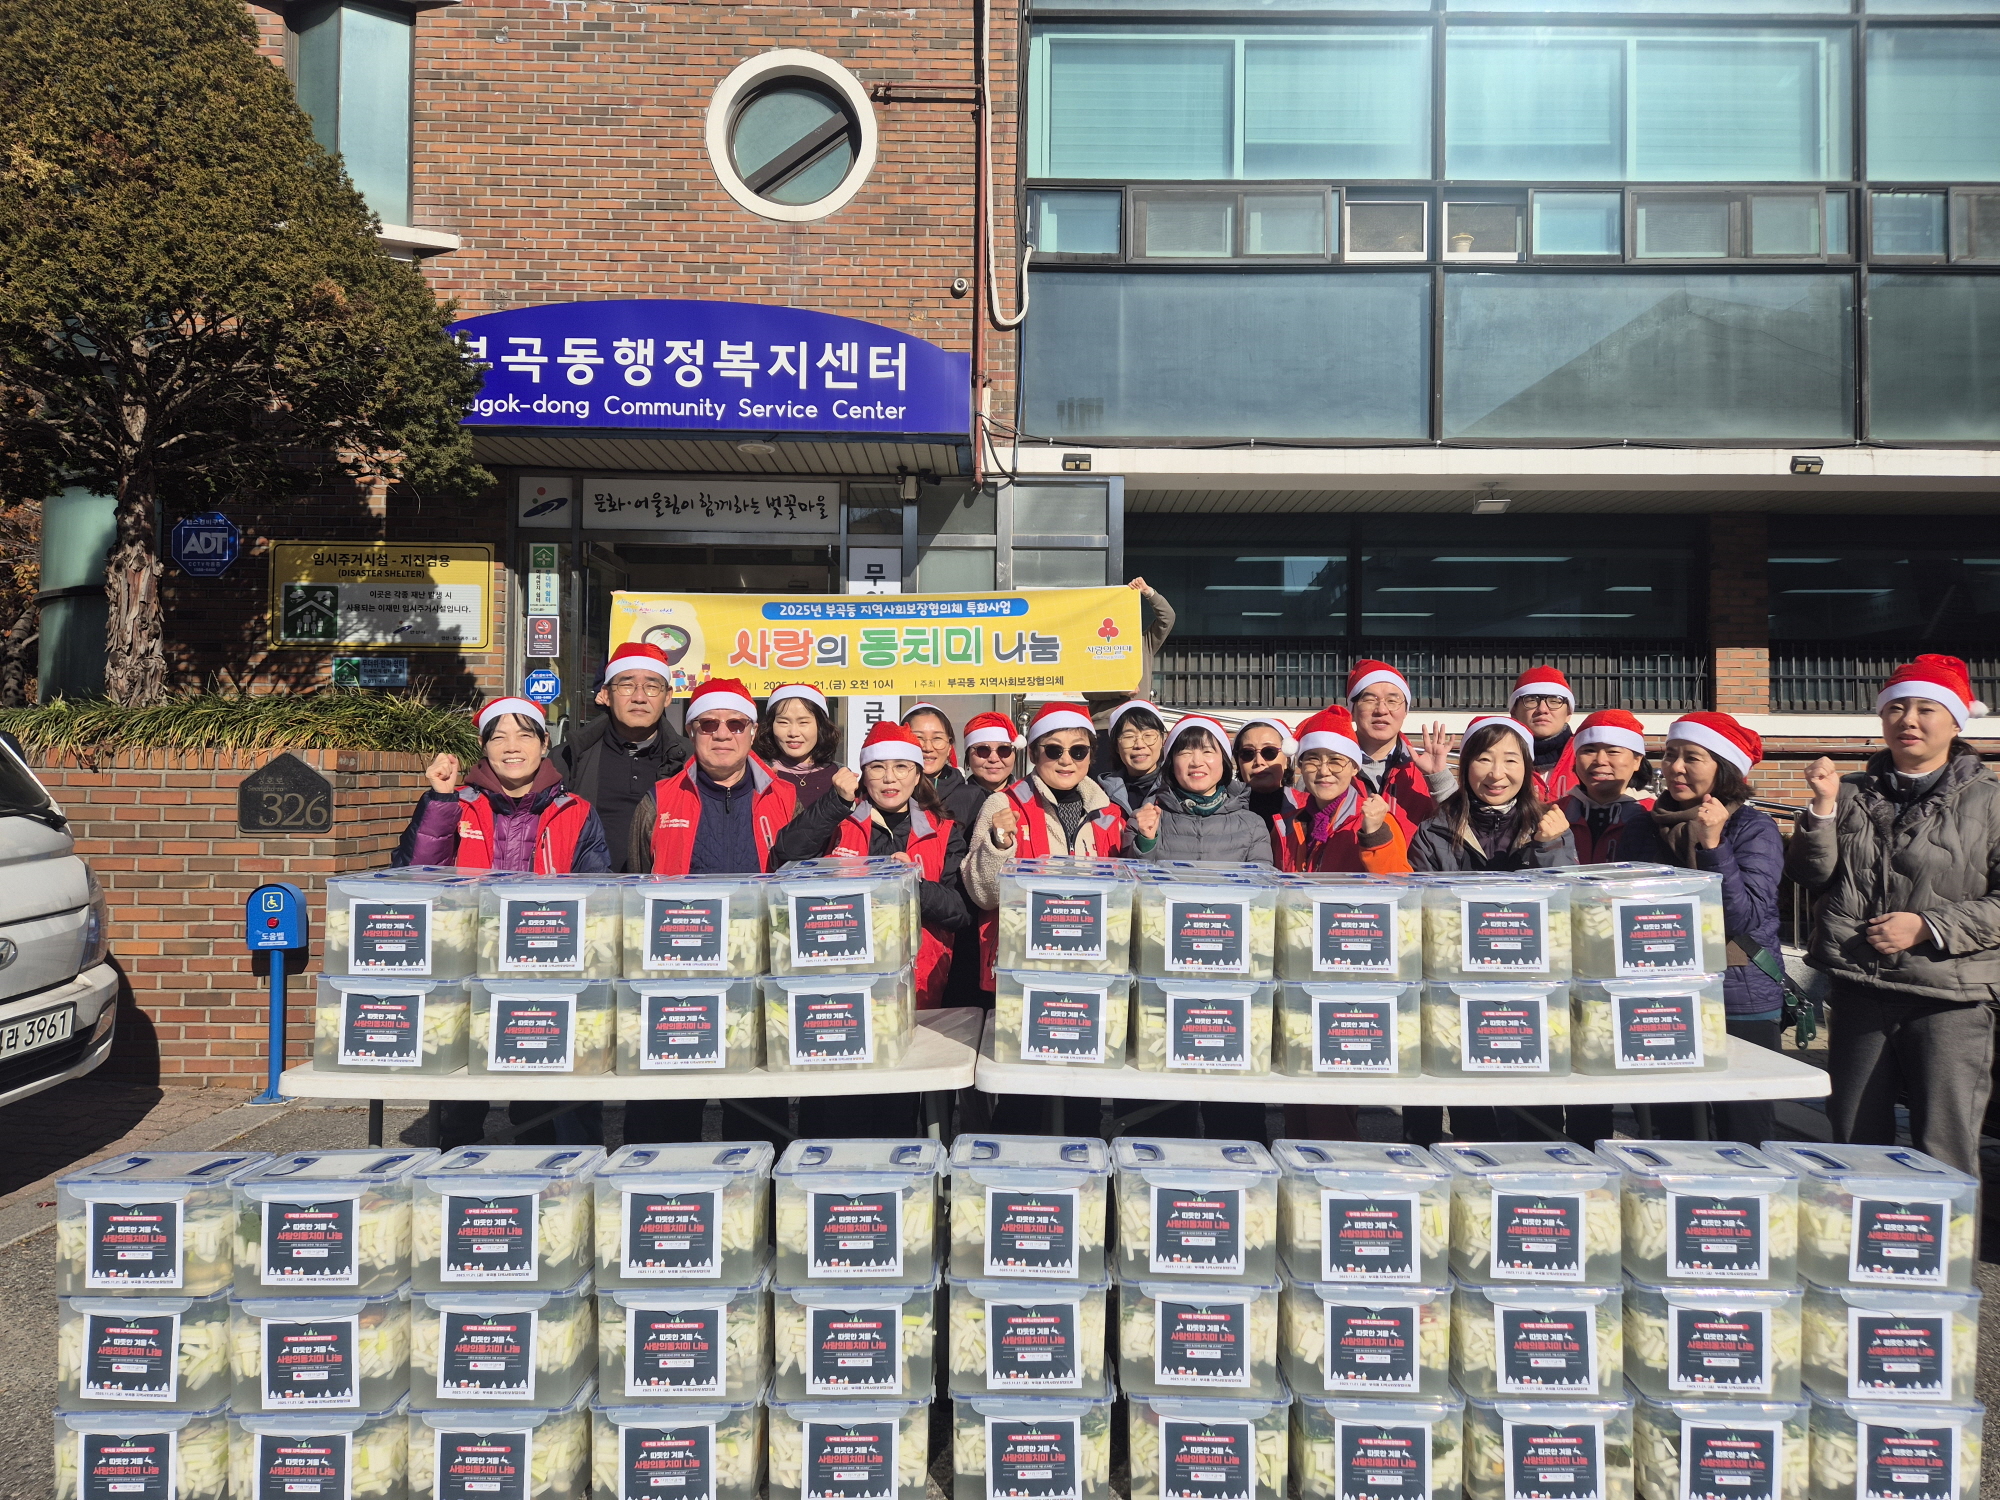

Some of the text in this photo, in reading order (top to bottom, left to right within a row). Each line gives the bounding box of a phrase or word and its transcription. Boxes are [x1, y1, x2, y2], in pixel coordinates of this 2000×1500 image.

[452, 393, 906, 421] ugok-dong Community Service Center
[699, 492, 760, 518] 함께하는
[766, 495, 828, 520] 벚꽃마을
[182, 532, 228, 554] ADT
[313, 552, 389, 568] 임시주거시설
[400, 553, 451, 568] 지진겸용
[338, 569, 425, 579] (DISASTER SHELTER)
[369, 590, 392, 599] 이곳은
[394, 590, 409, 599] 각종
[411, 591, 426, 599] 재난
[428, 591, 443, 599] 발생
[346, 604, 471, 613] 사용되는 이재민 임시주거시설입니다.
[780, 600, 1011, 618] 2025년 부곡동 지역사회보장협의체 특화사업
[729, 626, 1060, 668] 사랑의 동치미 나눔
[530, 680, 556, 693] ADT
[850, 679, 874, 690] 오전
[874, 679, 893, 690] 10시
[947, 677, 976, 688] 부곡동
[980, 676, 1064, 688] 지역사회보장협의체
[259, 793, 328, 826] 326
[261, 932, 285, 941] 도움벨
[24, 1010, 67, 1047] 3961
